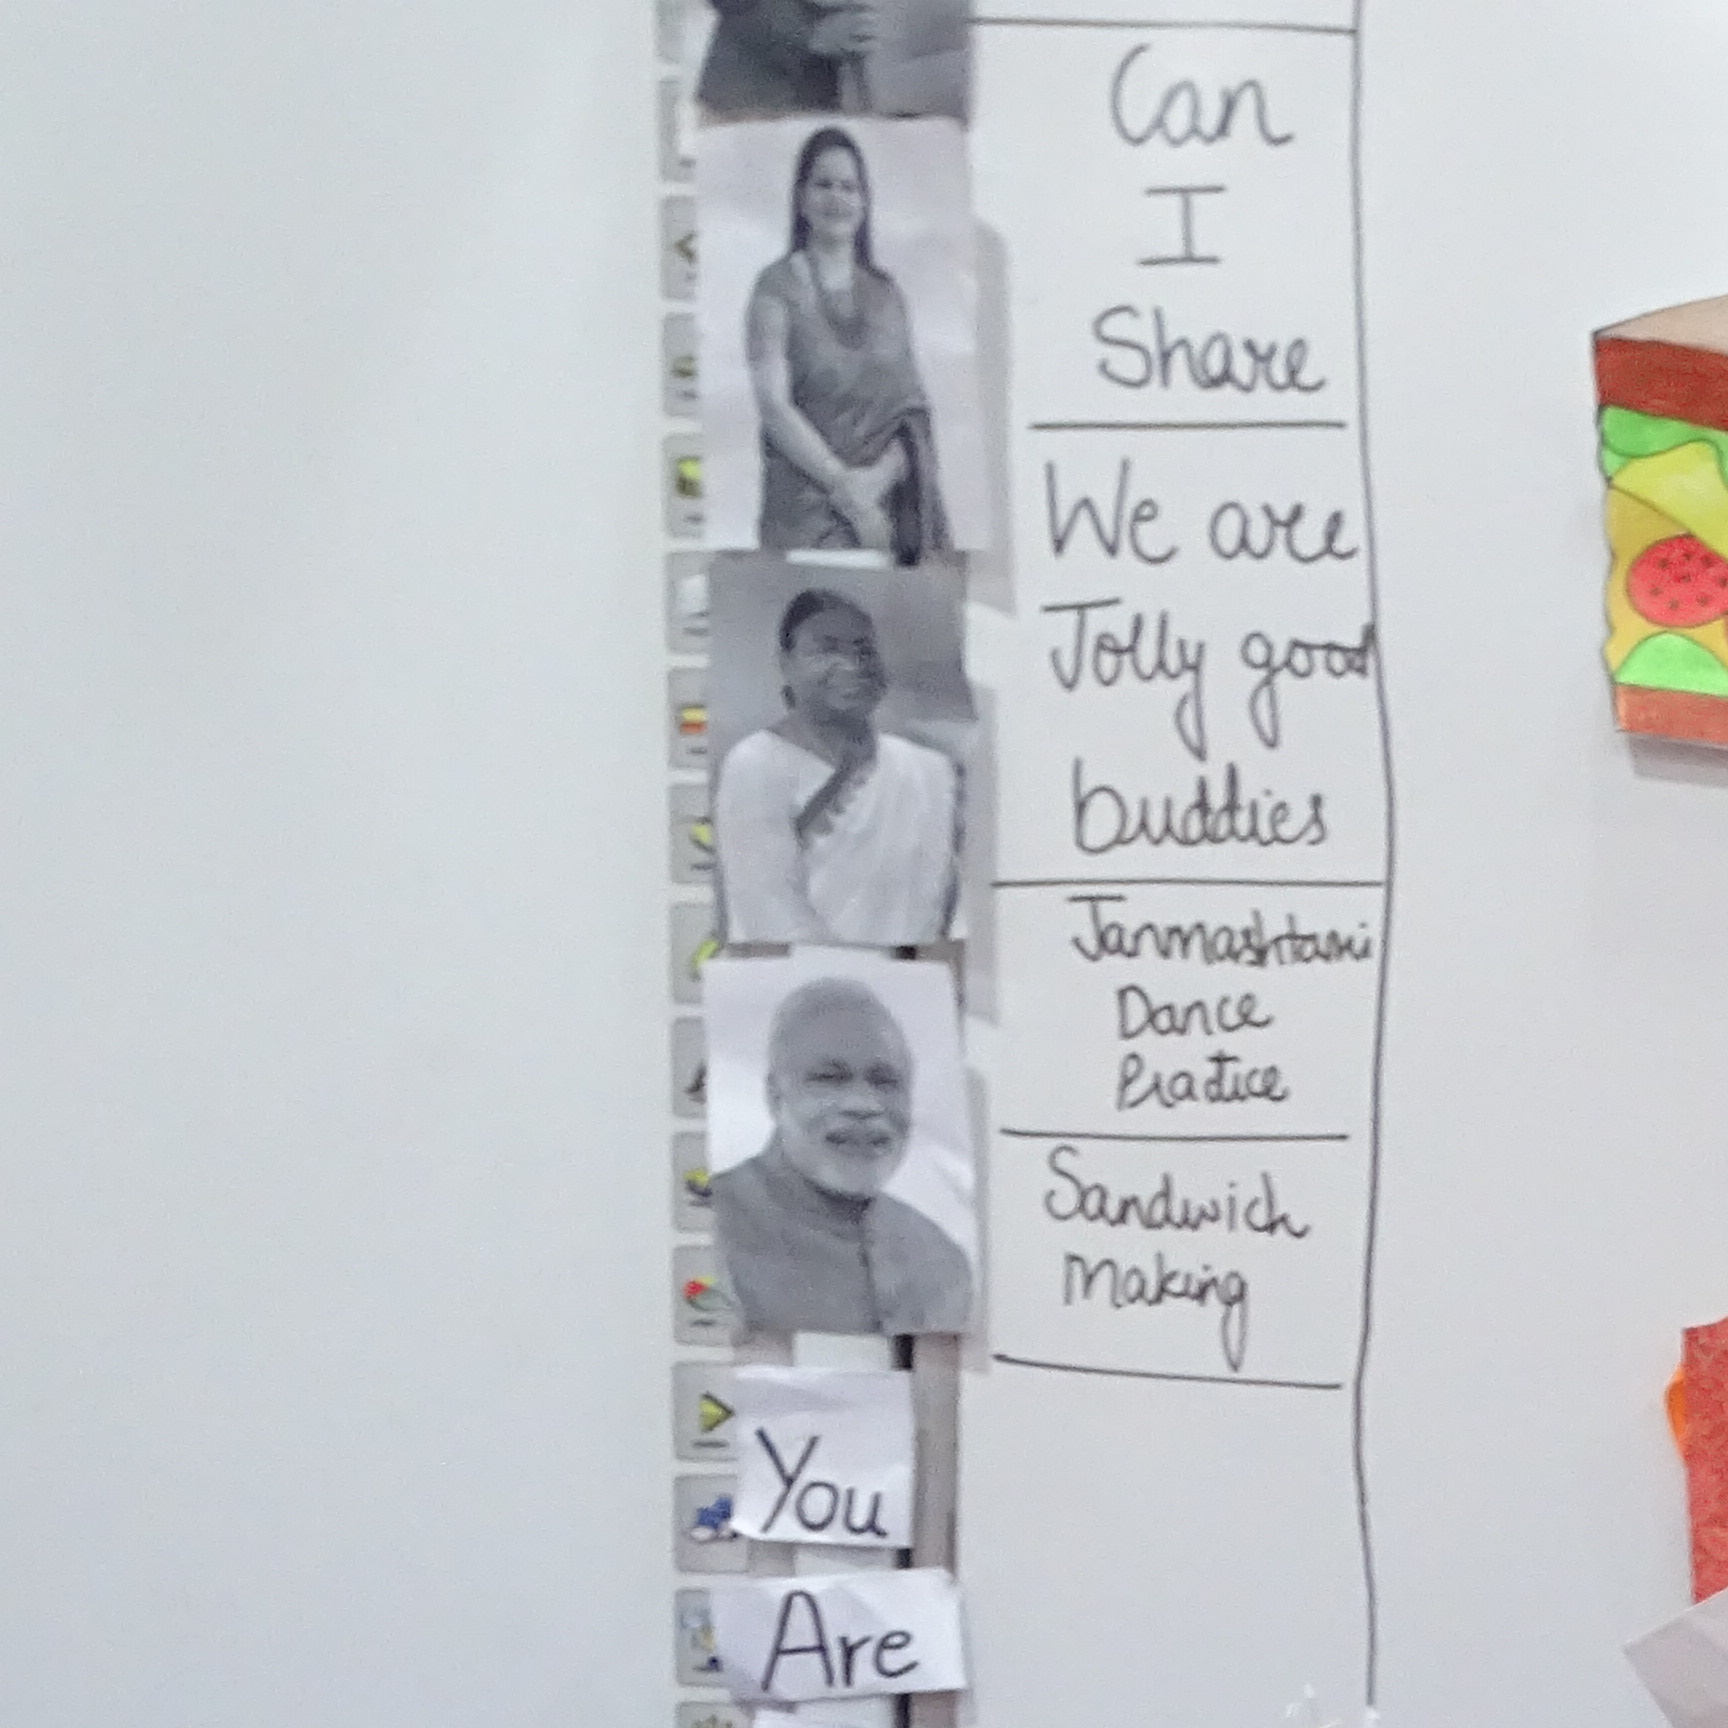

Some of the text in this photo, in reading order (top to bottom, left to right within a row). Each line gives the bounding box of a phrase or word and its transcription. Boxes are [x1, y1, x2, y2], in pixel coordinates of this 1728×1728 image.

[1109, 42, 1294, 148] Can
[1137, 184, 1227, 267] I
[1092, 304, 1327, 395] Share
[1043, 458, 1359, 564] We are
[1040, 597, 1378, 763] Jolly good
[1071, 755, 1328, 857] buddies
[1115, 982, 1276, 1040] Dance
[1043, 1144, 1313, 1241] Sandwich
[1062, 1249, 1250, 1375] Making
[754, 1427, 888, 1538] You
[762, 1590, 919, 1692] Are
